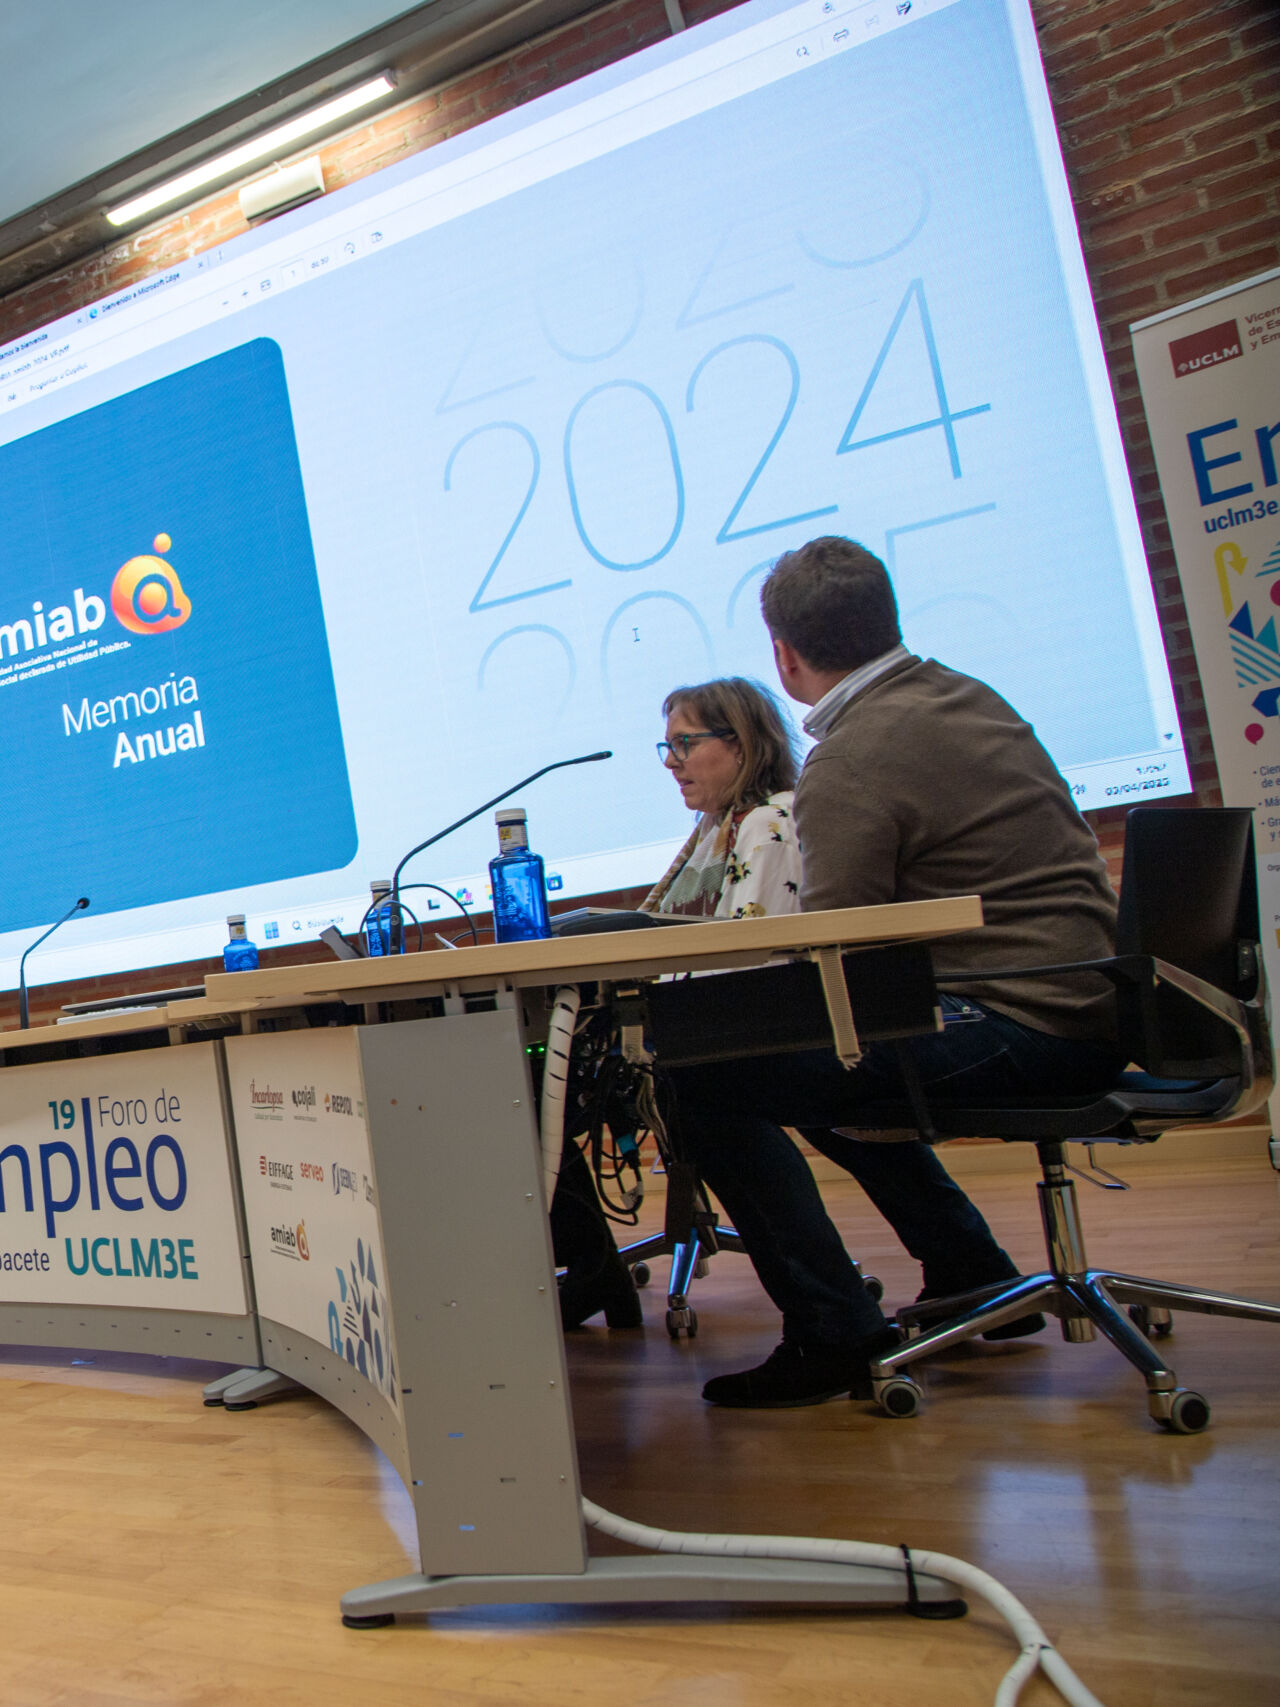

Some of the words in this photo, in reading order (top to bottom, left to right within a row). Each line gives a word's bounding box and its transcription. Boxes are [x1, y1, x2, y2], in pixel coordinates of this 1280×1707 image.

[1187, 344, 1239, 370] UCLM
[443, 276, 992, 614] 2024
[14, 654, 52, 672] Asociativa
[52, 641, 86, 659] Nacional
[87, 639, 98, 648] de
[19, 664, 55, 681] declarada
[56, 659, 67, 669] de
[67, 650, 99, 665] Utilidad
[62, 672, 199, 737] Memoria
[112, 710, 206, 768] Anual
[48, 1099, 75, 1130] 19
[97, 1096, 148, 1127] Foro
[154, 1088, 181, 1123] de
[331, 1094, 353, 1116] REPSOL
[268, 1162, 294, 1181] EIFFAGE
[300, 1162, 324, 1183] serveo
[270, 1224, 296, 1247] amiab
[65, 1237, 199, 1280] UCLM3E
